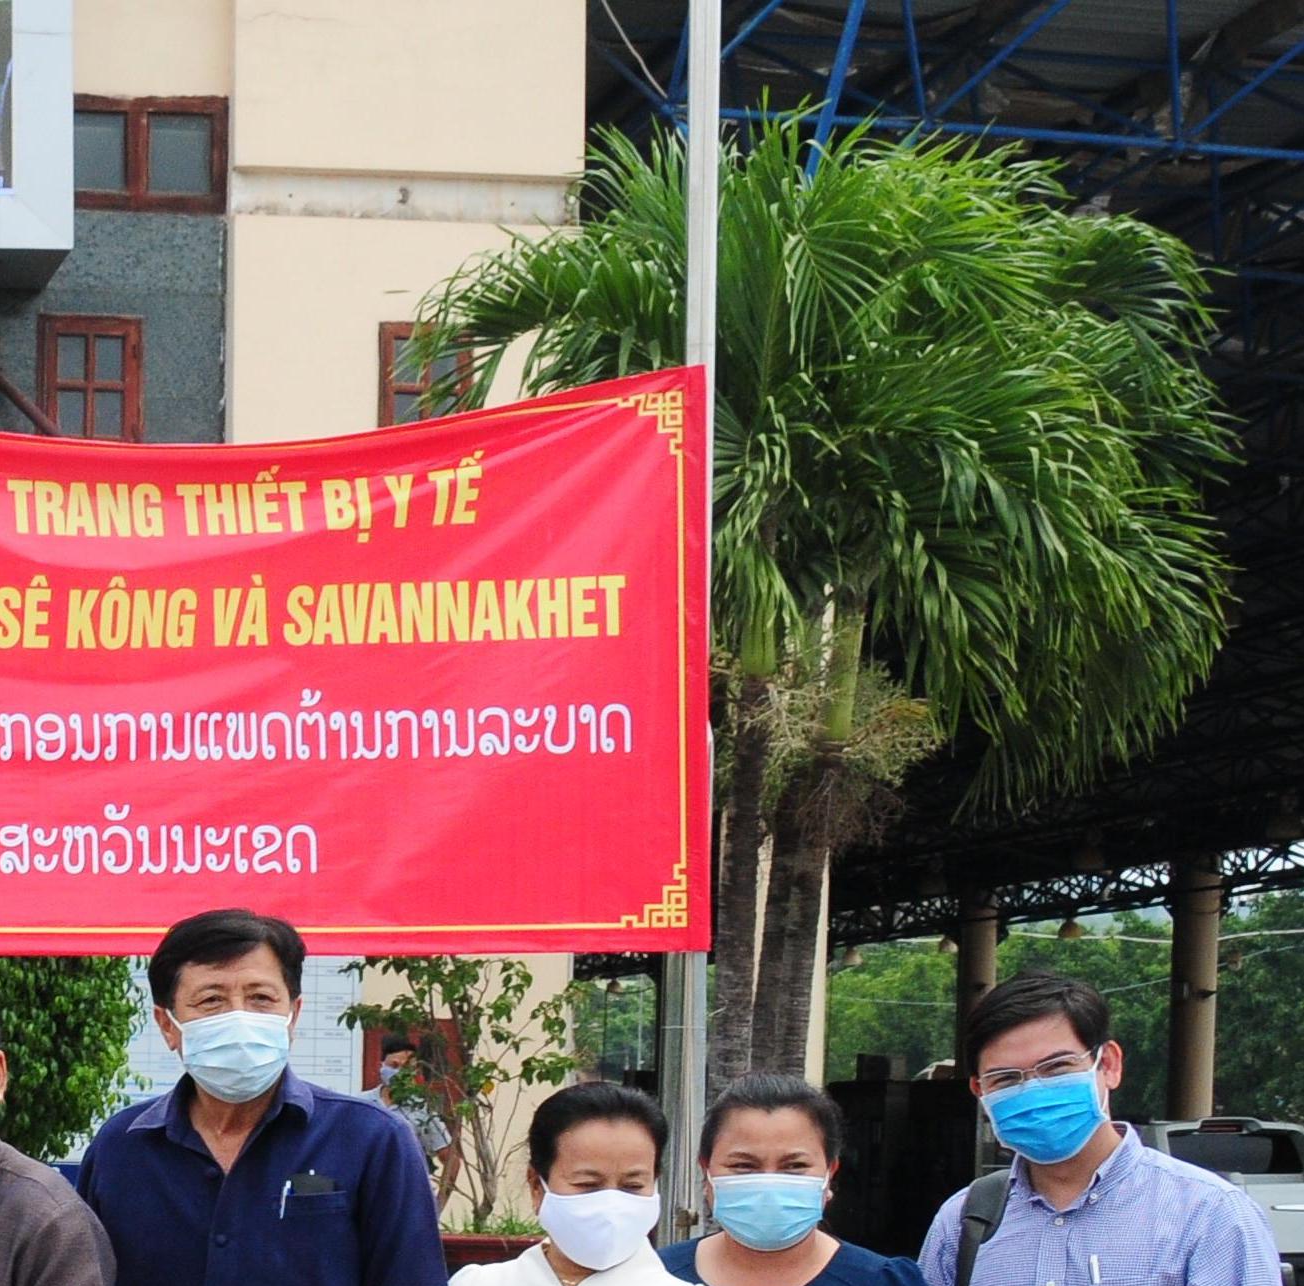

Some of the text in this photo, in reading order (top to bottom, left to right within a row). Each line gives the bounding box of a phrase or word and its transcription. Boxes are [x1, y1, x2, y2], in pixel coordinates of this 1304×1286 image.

[7, 479, 165, 538] TRANG
[176, 471, 307, 536] THIẾT
[322, 477, 373, 543] BỊ
[383, 473, 414, 528] Y
[428, 450, 484, 526] TẾ
[66, 575, 198, 650] KÔNG
[213, 574, 269, 647] VÀ
[283, 574, 626, 646] SAVANNAKHET
